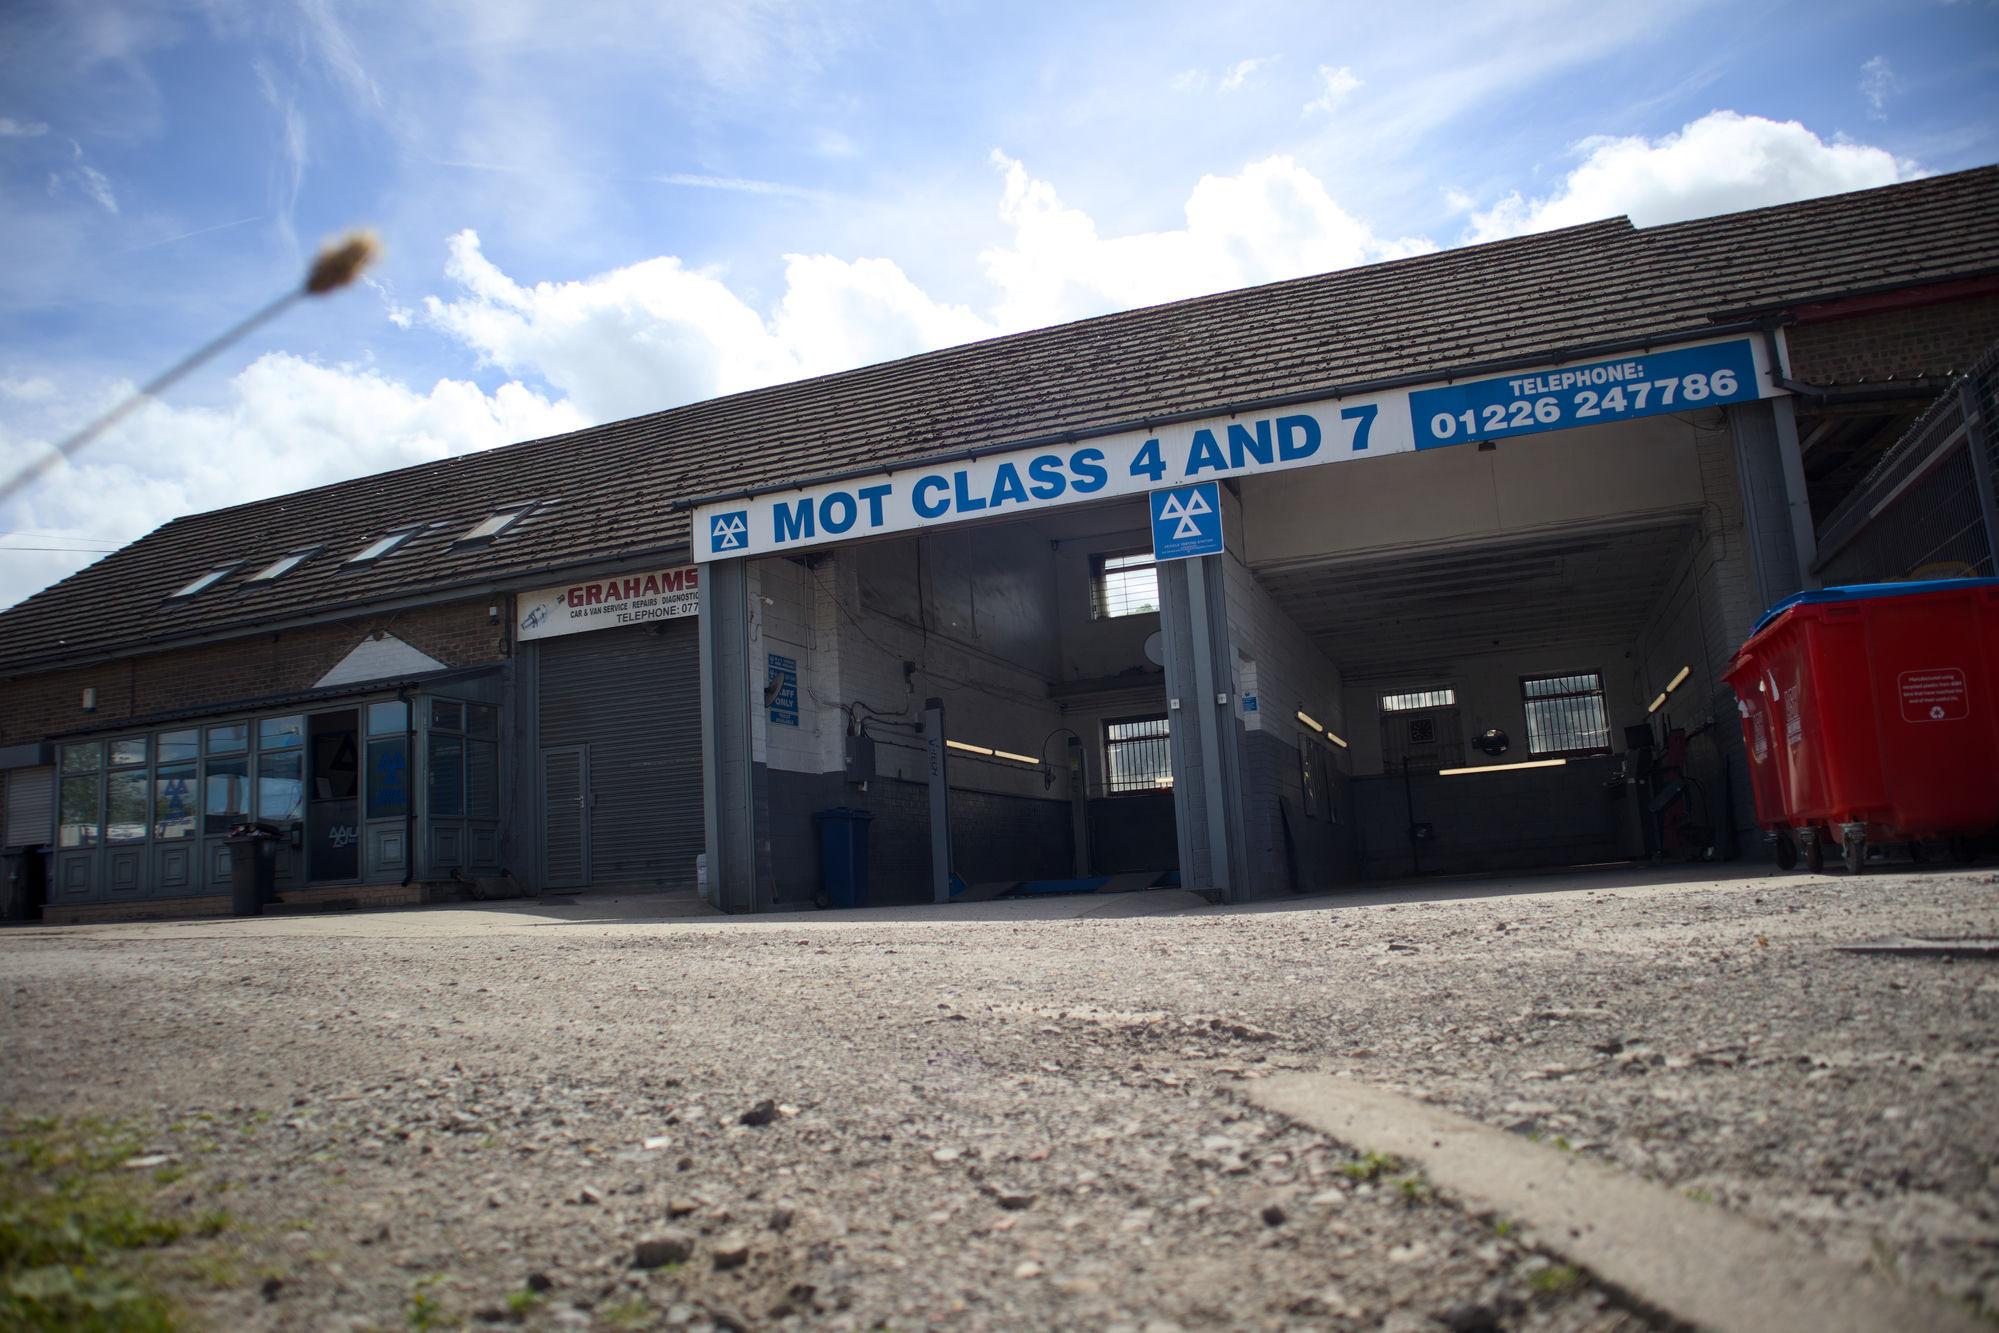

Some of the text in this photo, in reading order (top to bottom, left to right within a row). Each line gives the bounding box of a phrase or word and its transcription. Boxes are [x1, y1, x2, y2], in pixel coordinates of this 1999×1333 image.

[1509, 362, 1644, 397] TELEPHONE:
[1430, 369, 1738, 439] 01226 247786
[773, 403, 1379, 544] MOT CLASS 4 AND 7
[567, 568, 699, 608] GRAHAMS
[570, 609, 583, 618] CAR
[583, 608, 589, 617] &
[589, 607, 602, 616] VAN
[602, 602, 628, 614] SERVICE
[632, 598, 658, 609] REPAIRS
[617, 605, 680, 623] TELEPHONE:
[776, 697, 794, 708] ONLY
